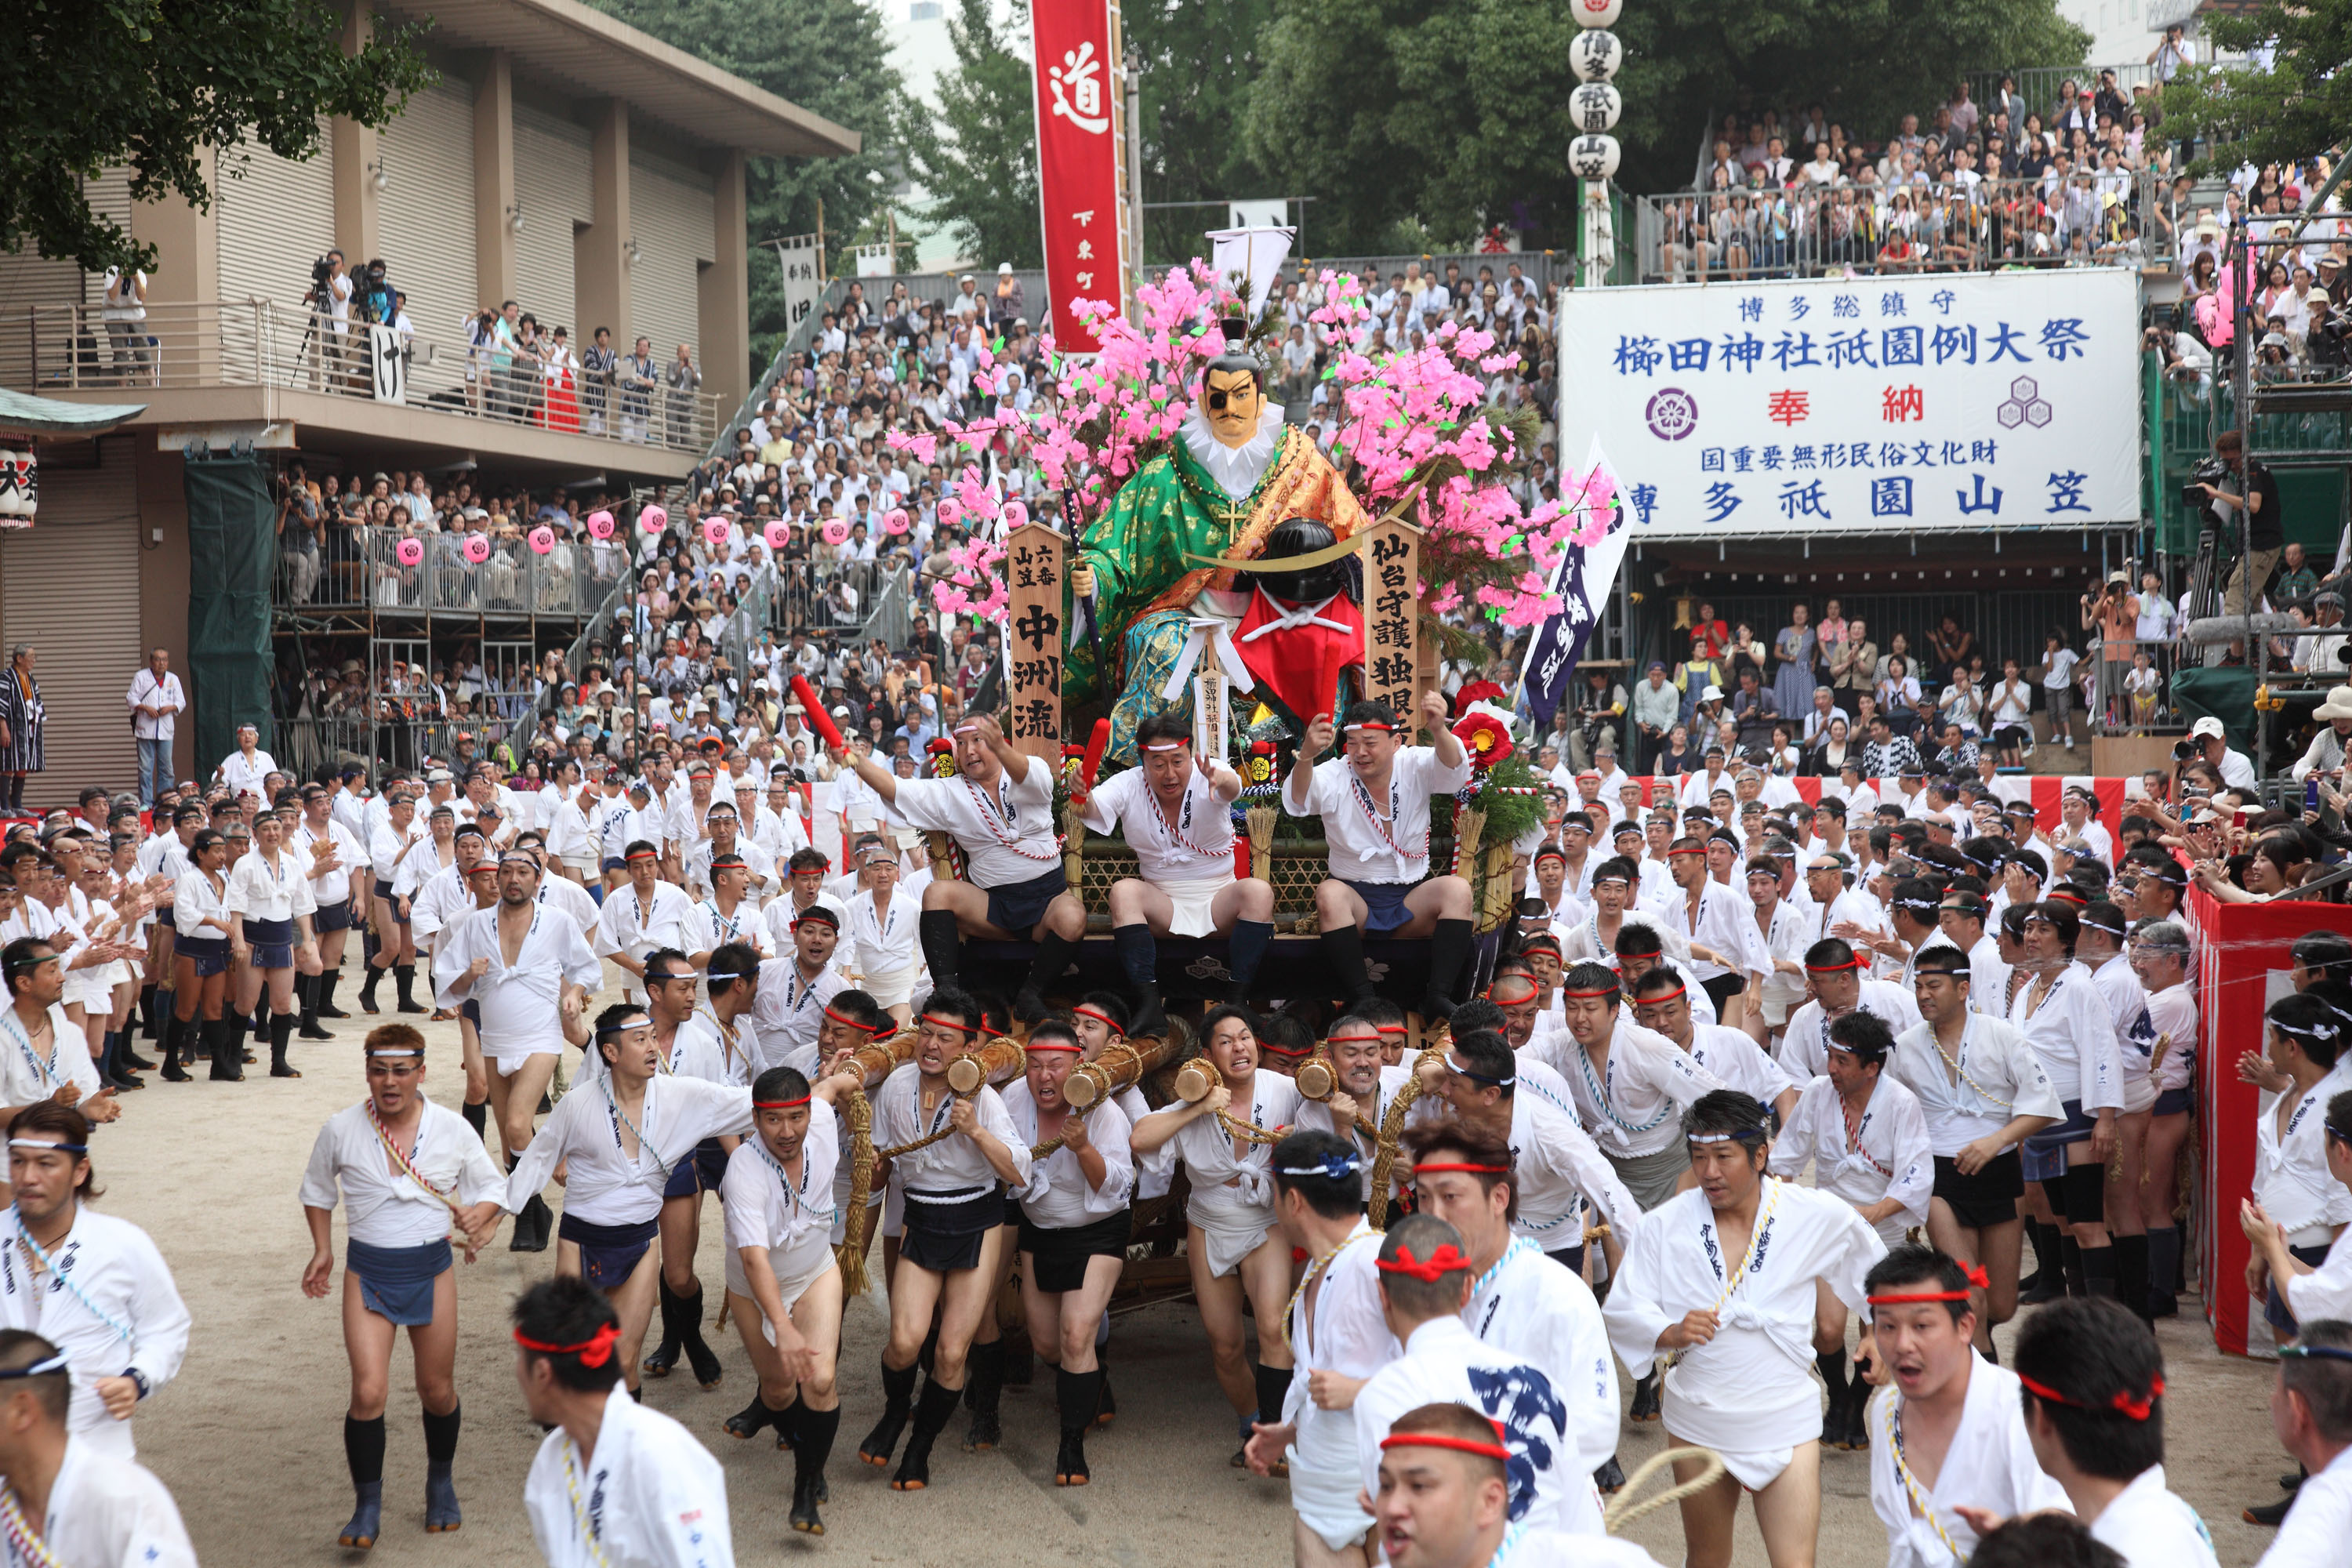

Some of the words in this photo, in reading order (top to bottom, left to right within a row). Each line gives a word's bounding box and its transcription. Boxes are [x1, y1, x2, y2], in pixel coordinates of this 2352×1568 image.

[1582, 31, 1613, 78] 博多
[1048, 41, 1109, 135] 道
[1579, 84, 1613, 129] 祇園
[1576, 137, 1606, 177] 山笠
[1072, 209, 1095, 290] 下東町
[1738, 289, 1957, 322] 博多総鎮守
[376, 329, 400, 399] け
[1612, 318, 2091, 377] 櫛田神社祇園例大祭
[1768, 383, 1925, 427] 奉納
[1700, 438, 1999, 473] 国重要無形民俗文化財
[1624, 470, 2092, 524] 博多祇園山笠
[1014, 546, 1037, 588] 山笠
[1036, 545, 1057, 586] 六番
[1370, 533, 1414, 747] 仙台守護独眼
[1014, 604, 1058, 739] 中洲流
